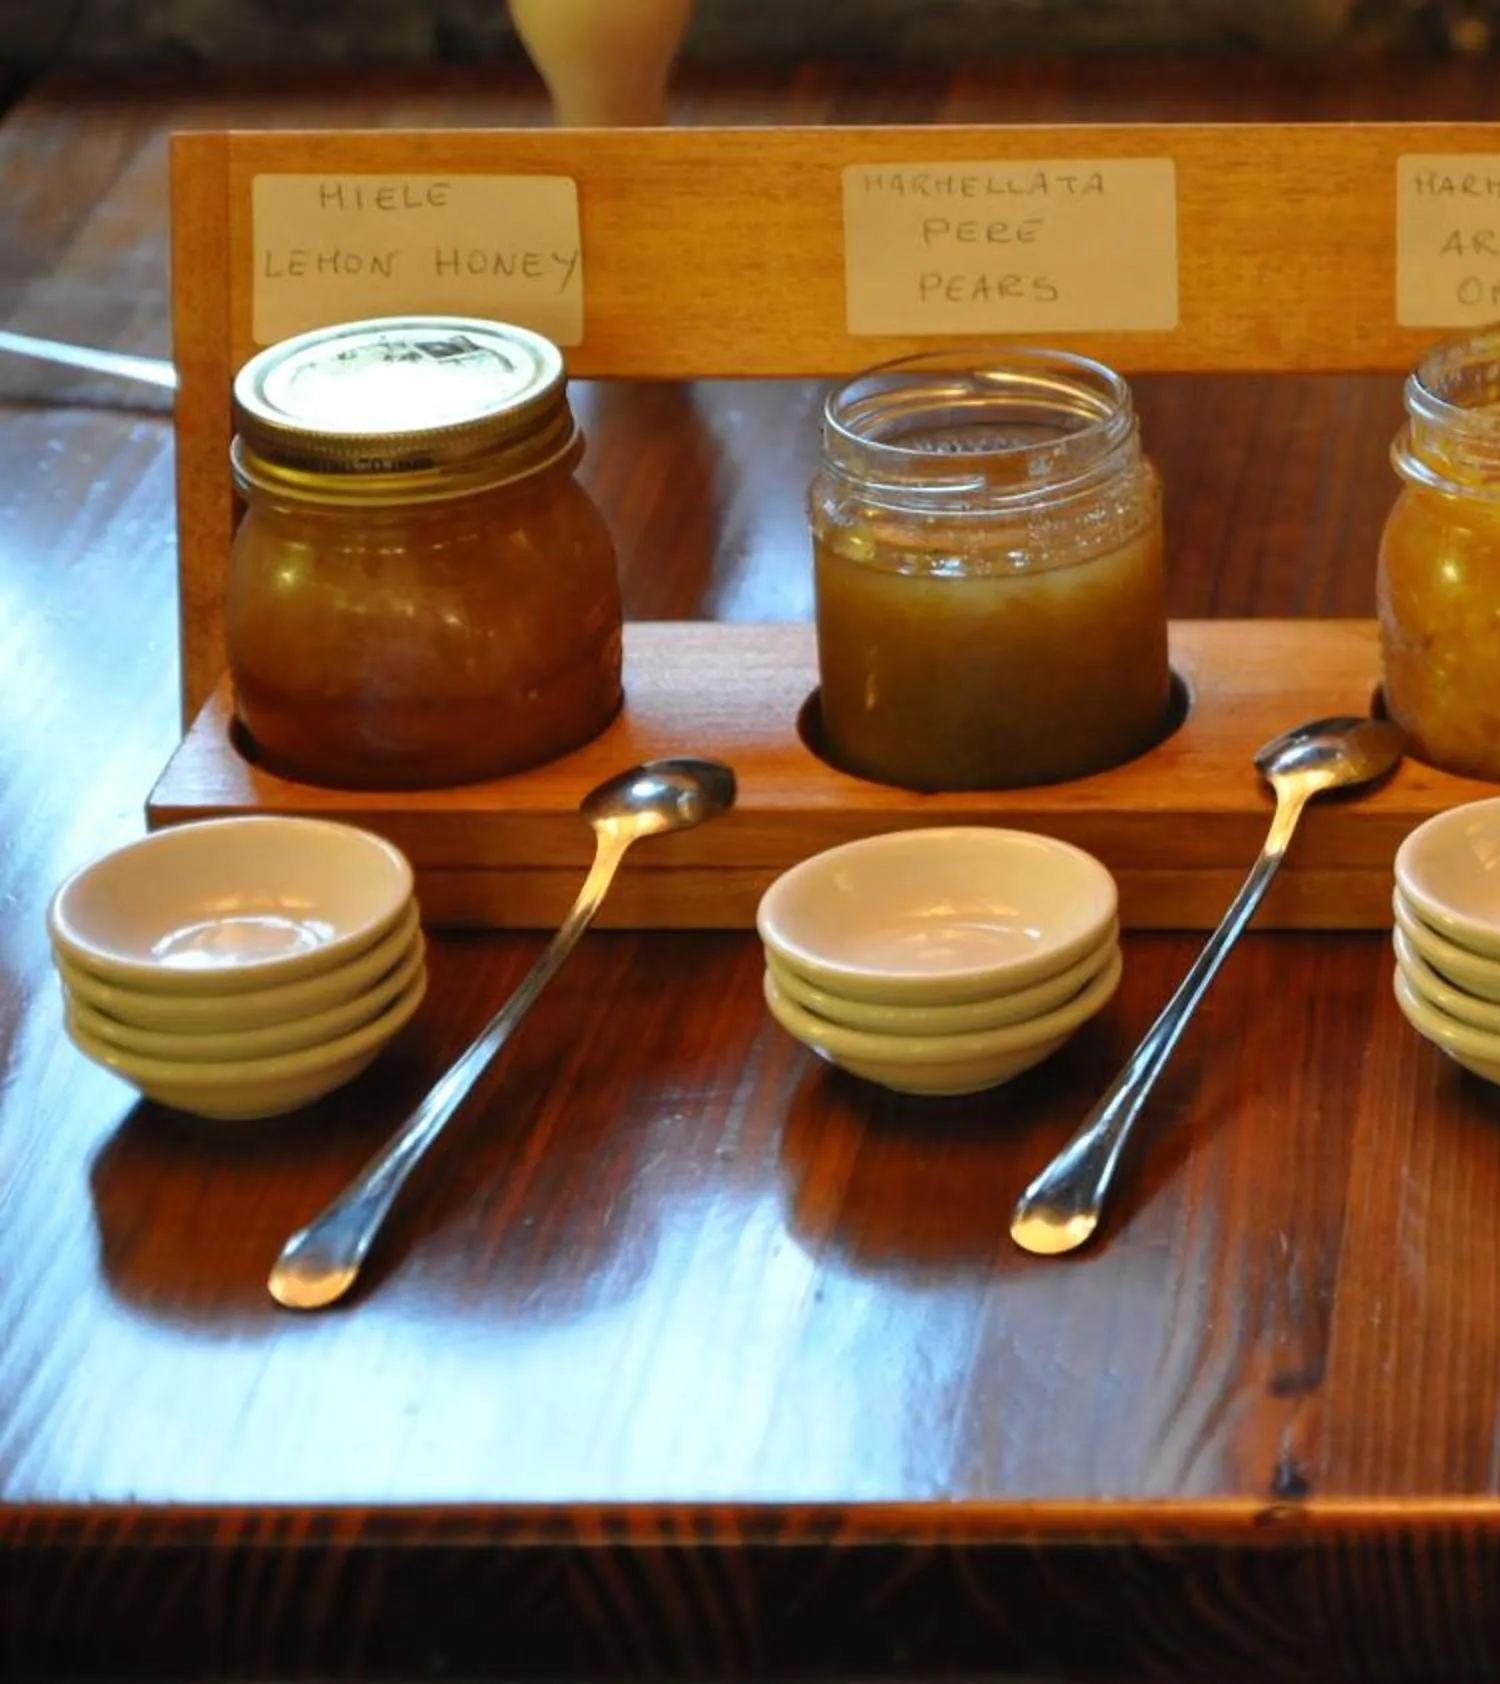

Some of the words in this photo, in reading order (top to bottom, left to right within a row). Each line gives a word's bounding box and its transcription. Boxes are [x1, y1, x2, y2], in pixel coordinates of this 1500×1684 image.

[318, 181, 451, 211] MIELE
[863, 171, 1107, 199] MARMELLATA
[922, 216, 1045, 246] PERE
[264, 248, 396, 278] LEMON
[434, 246, 578, 293] HONEY
[918, 272, 1059, 303] PEARS
